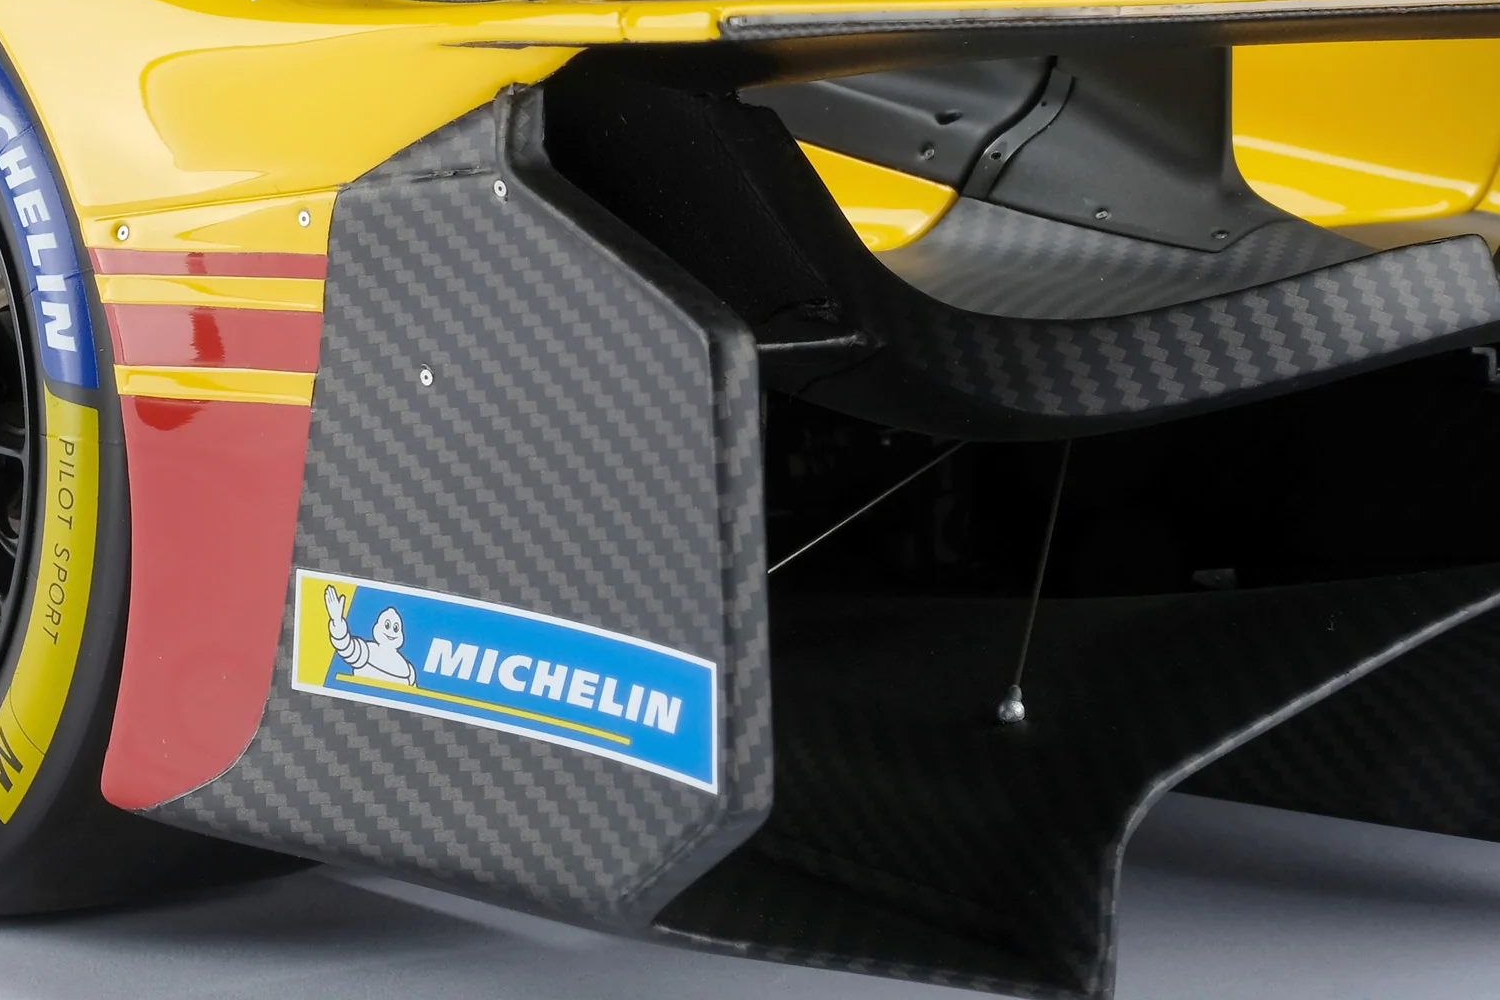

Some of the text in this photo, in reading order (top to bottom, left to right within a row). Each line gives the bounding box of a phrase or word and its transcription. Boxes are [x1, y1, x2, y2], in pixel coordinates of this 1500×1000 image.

[45, 438, 77, 646] PILOT SPORT
[423, 637, 682, 735] MICHELIN
